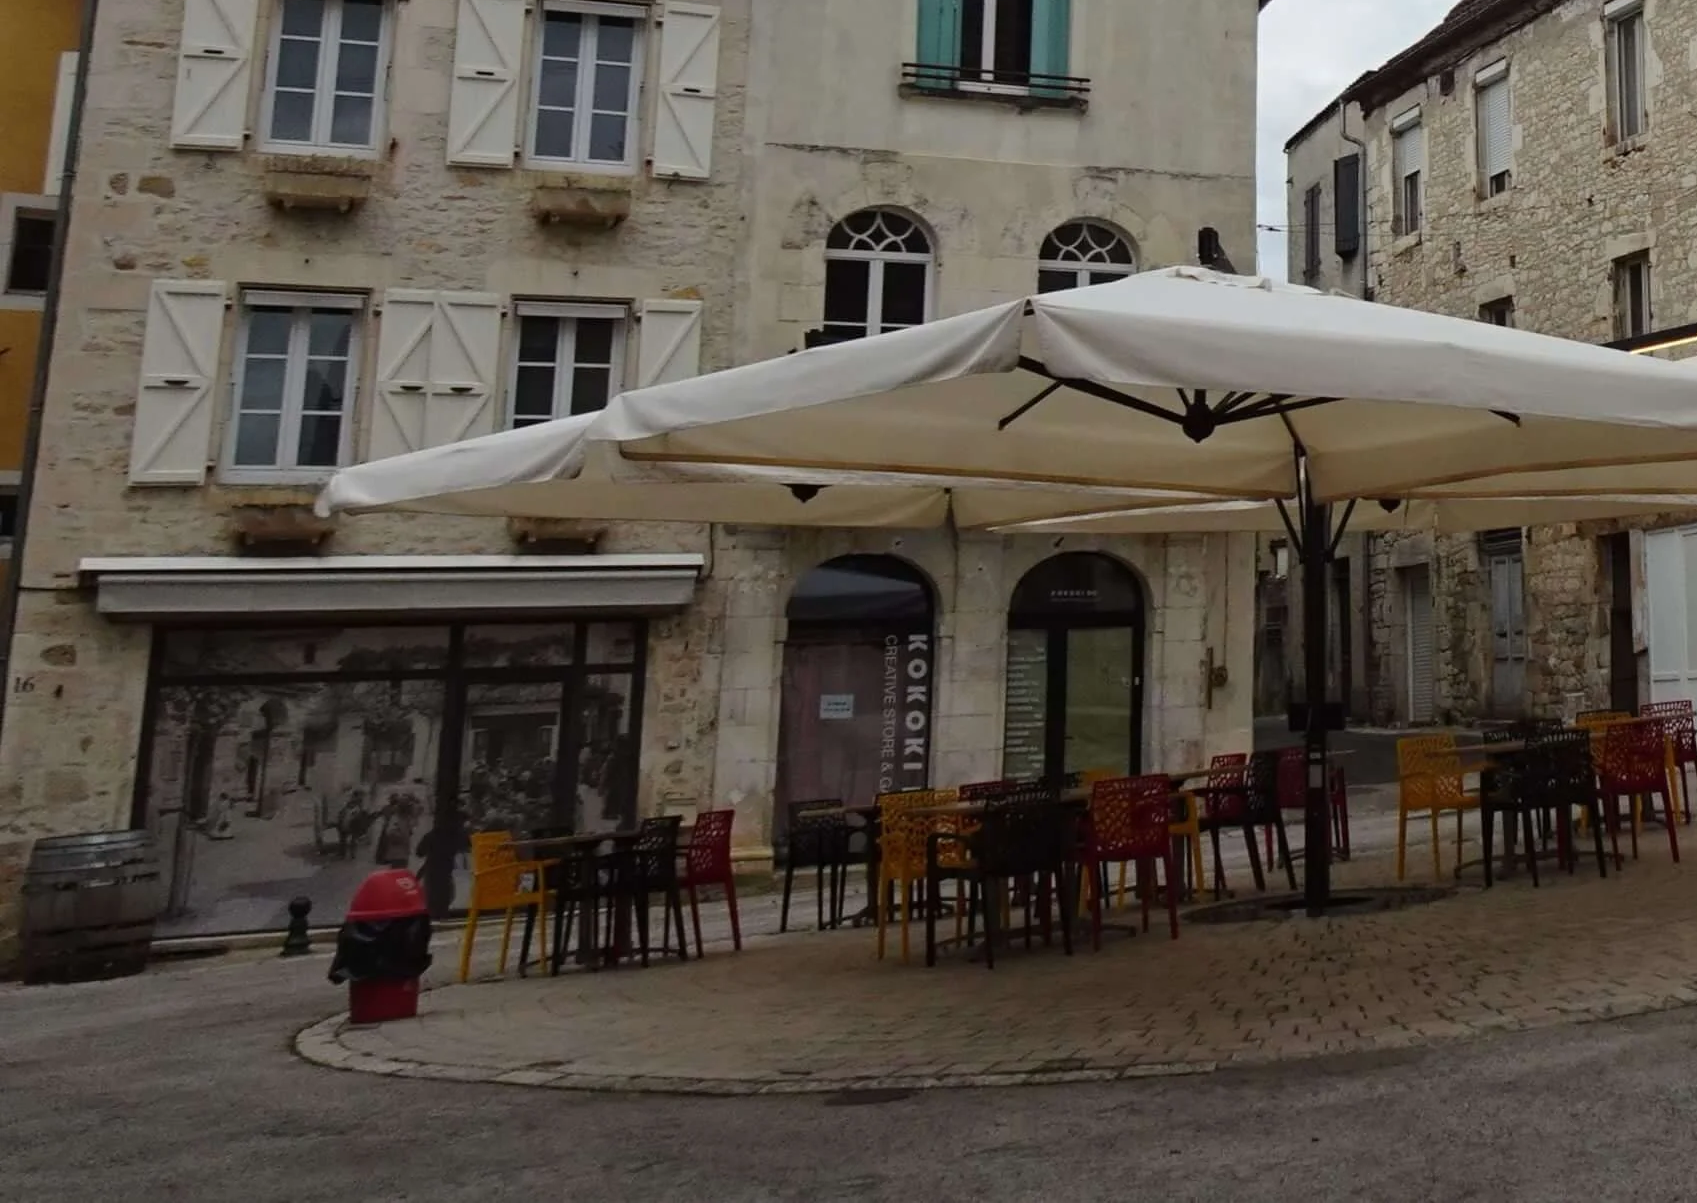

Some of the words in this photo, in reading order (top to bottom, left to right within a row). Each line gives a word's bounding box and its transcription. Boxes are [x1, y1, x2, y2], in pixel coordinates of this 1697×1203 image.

[14, 676, 35, 694] 16
[882, 634, 899, 704] CREATIVE
[903, 633, 929, 771] KOKOKI
[880, 707, 897, 758] STORE
